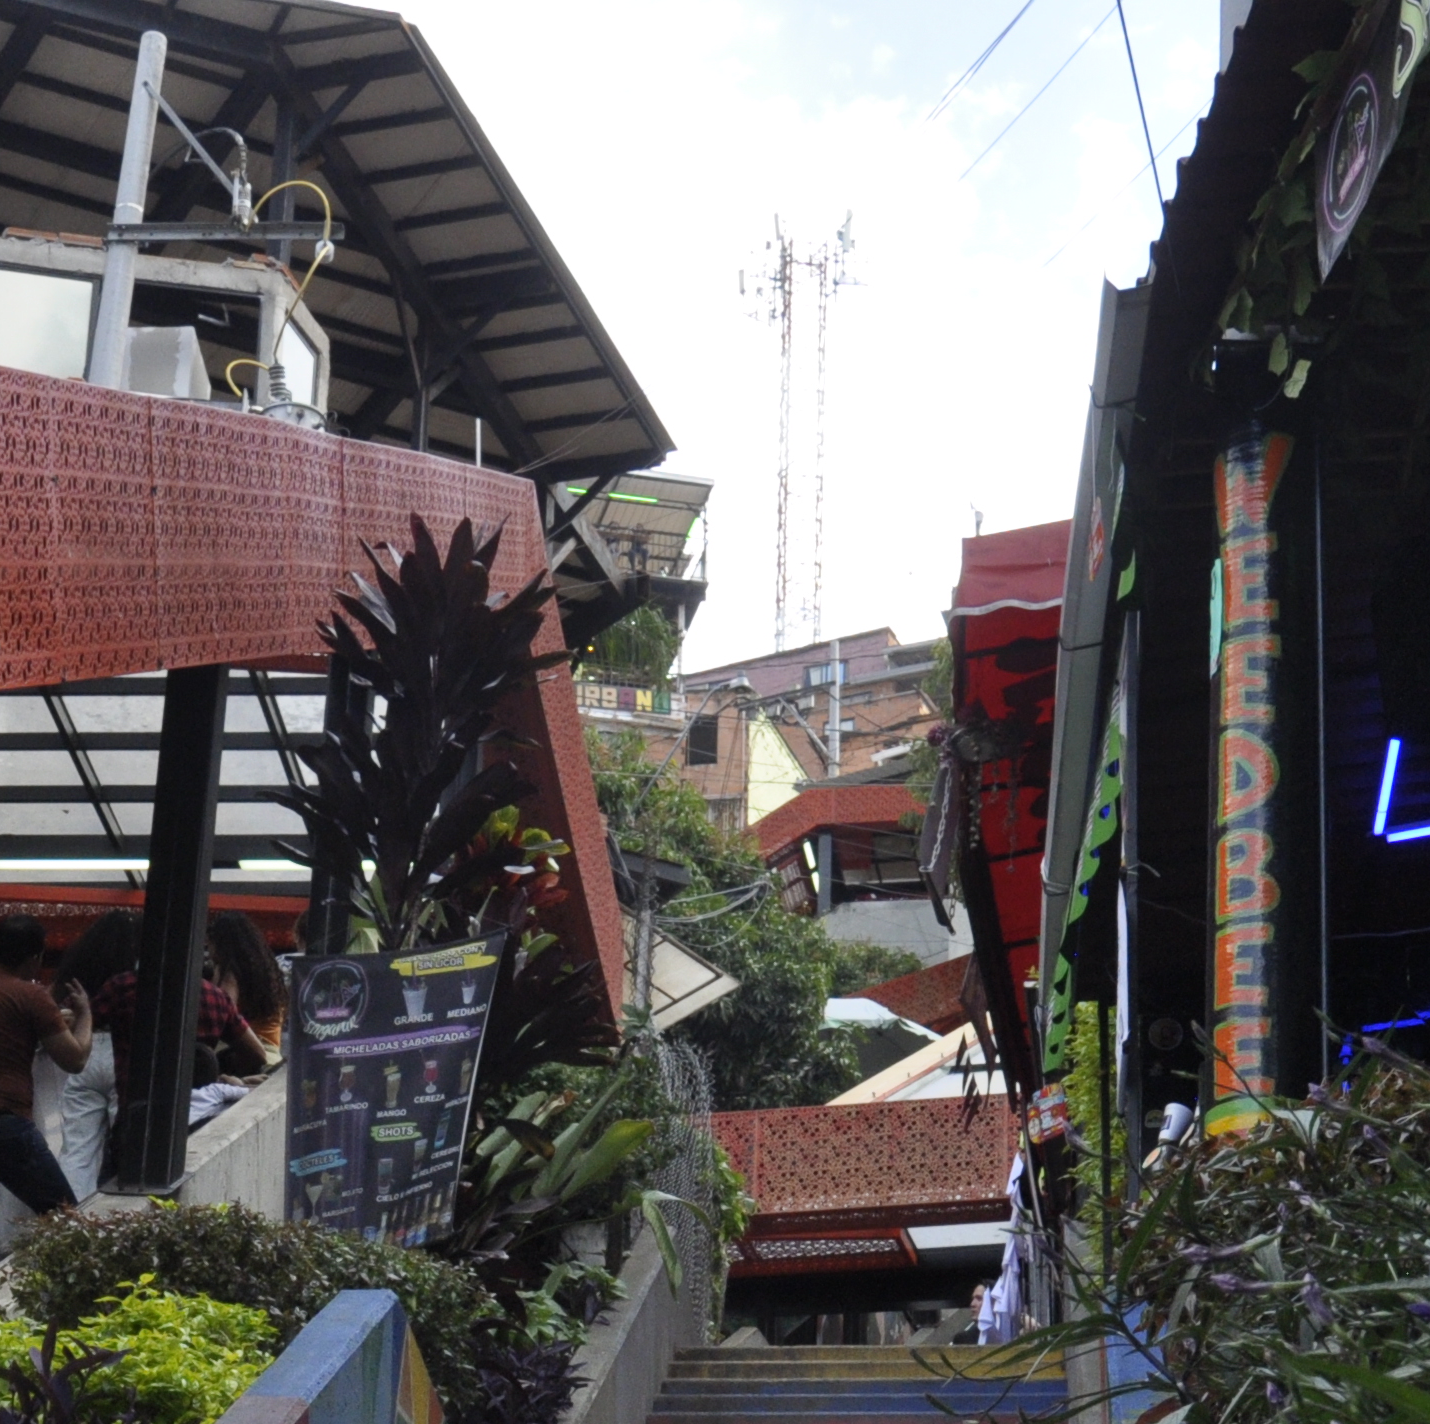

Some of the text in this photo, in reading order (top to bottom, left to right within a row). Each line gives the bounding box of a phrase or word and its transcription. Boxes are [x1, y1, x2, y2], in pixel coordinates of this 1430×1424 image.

[418, 957, 464, 970] SIN LICOR
[394, 1003, 487, 1025] GRANDE MEDIANO
[333, 1030, 472, 1054] MICHELADAS SABORIZADAS
[413, 1093, 446, 1104] CEREZA
[325, 1101, 369, 1114] TAMARINDO
[376, 1108, 407, 1119] MANGO
[378, 1126, 414, 1138] SHOTS
